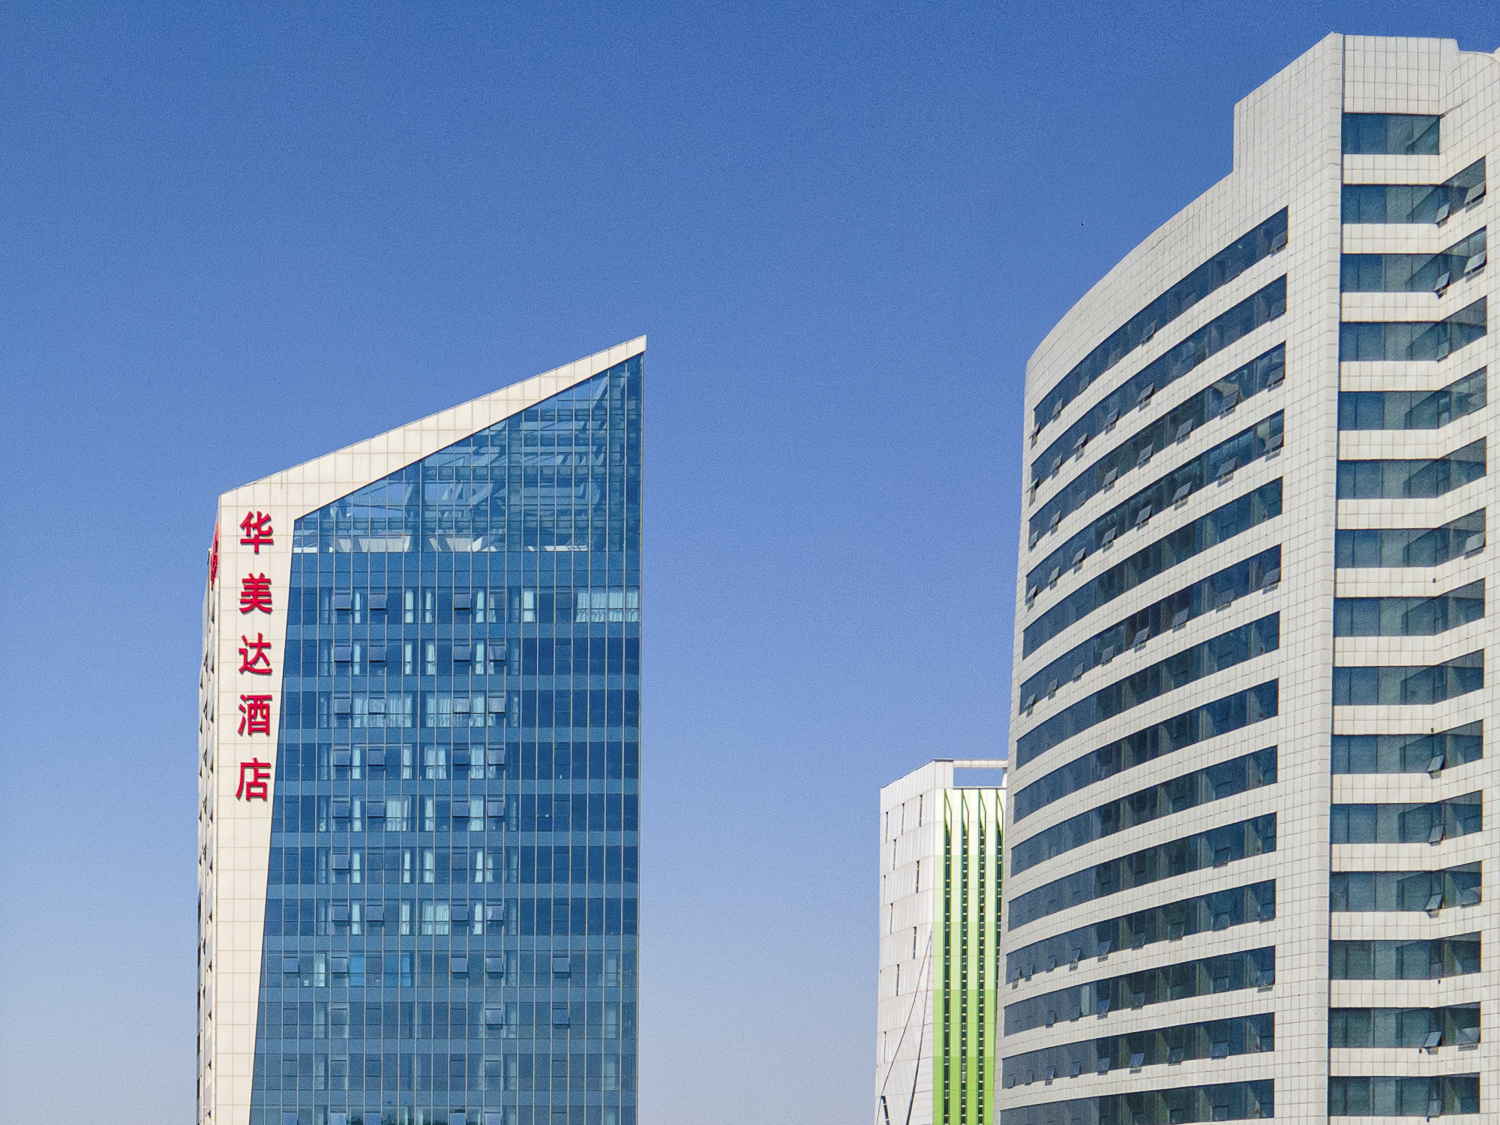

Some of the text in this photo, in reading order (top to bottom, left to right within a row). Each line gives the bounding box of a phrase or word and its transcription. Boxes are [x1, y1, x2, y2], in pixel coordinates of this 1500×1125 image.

[235, 511, 274, 801] 华美达酒店
